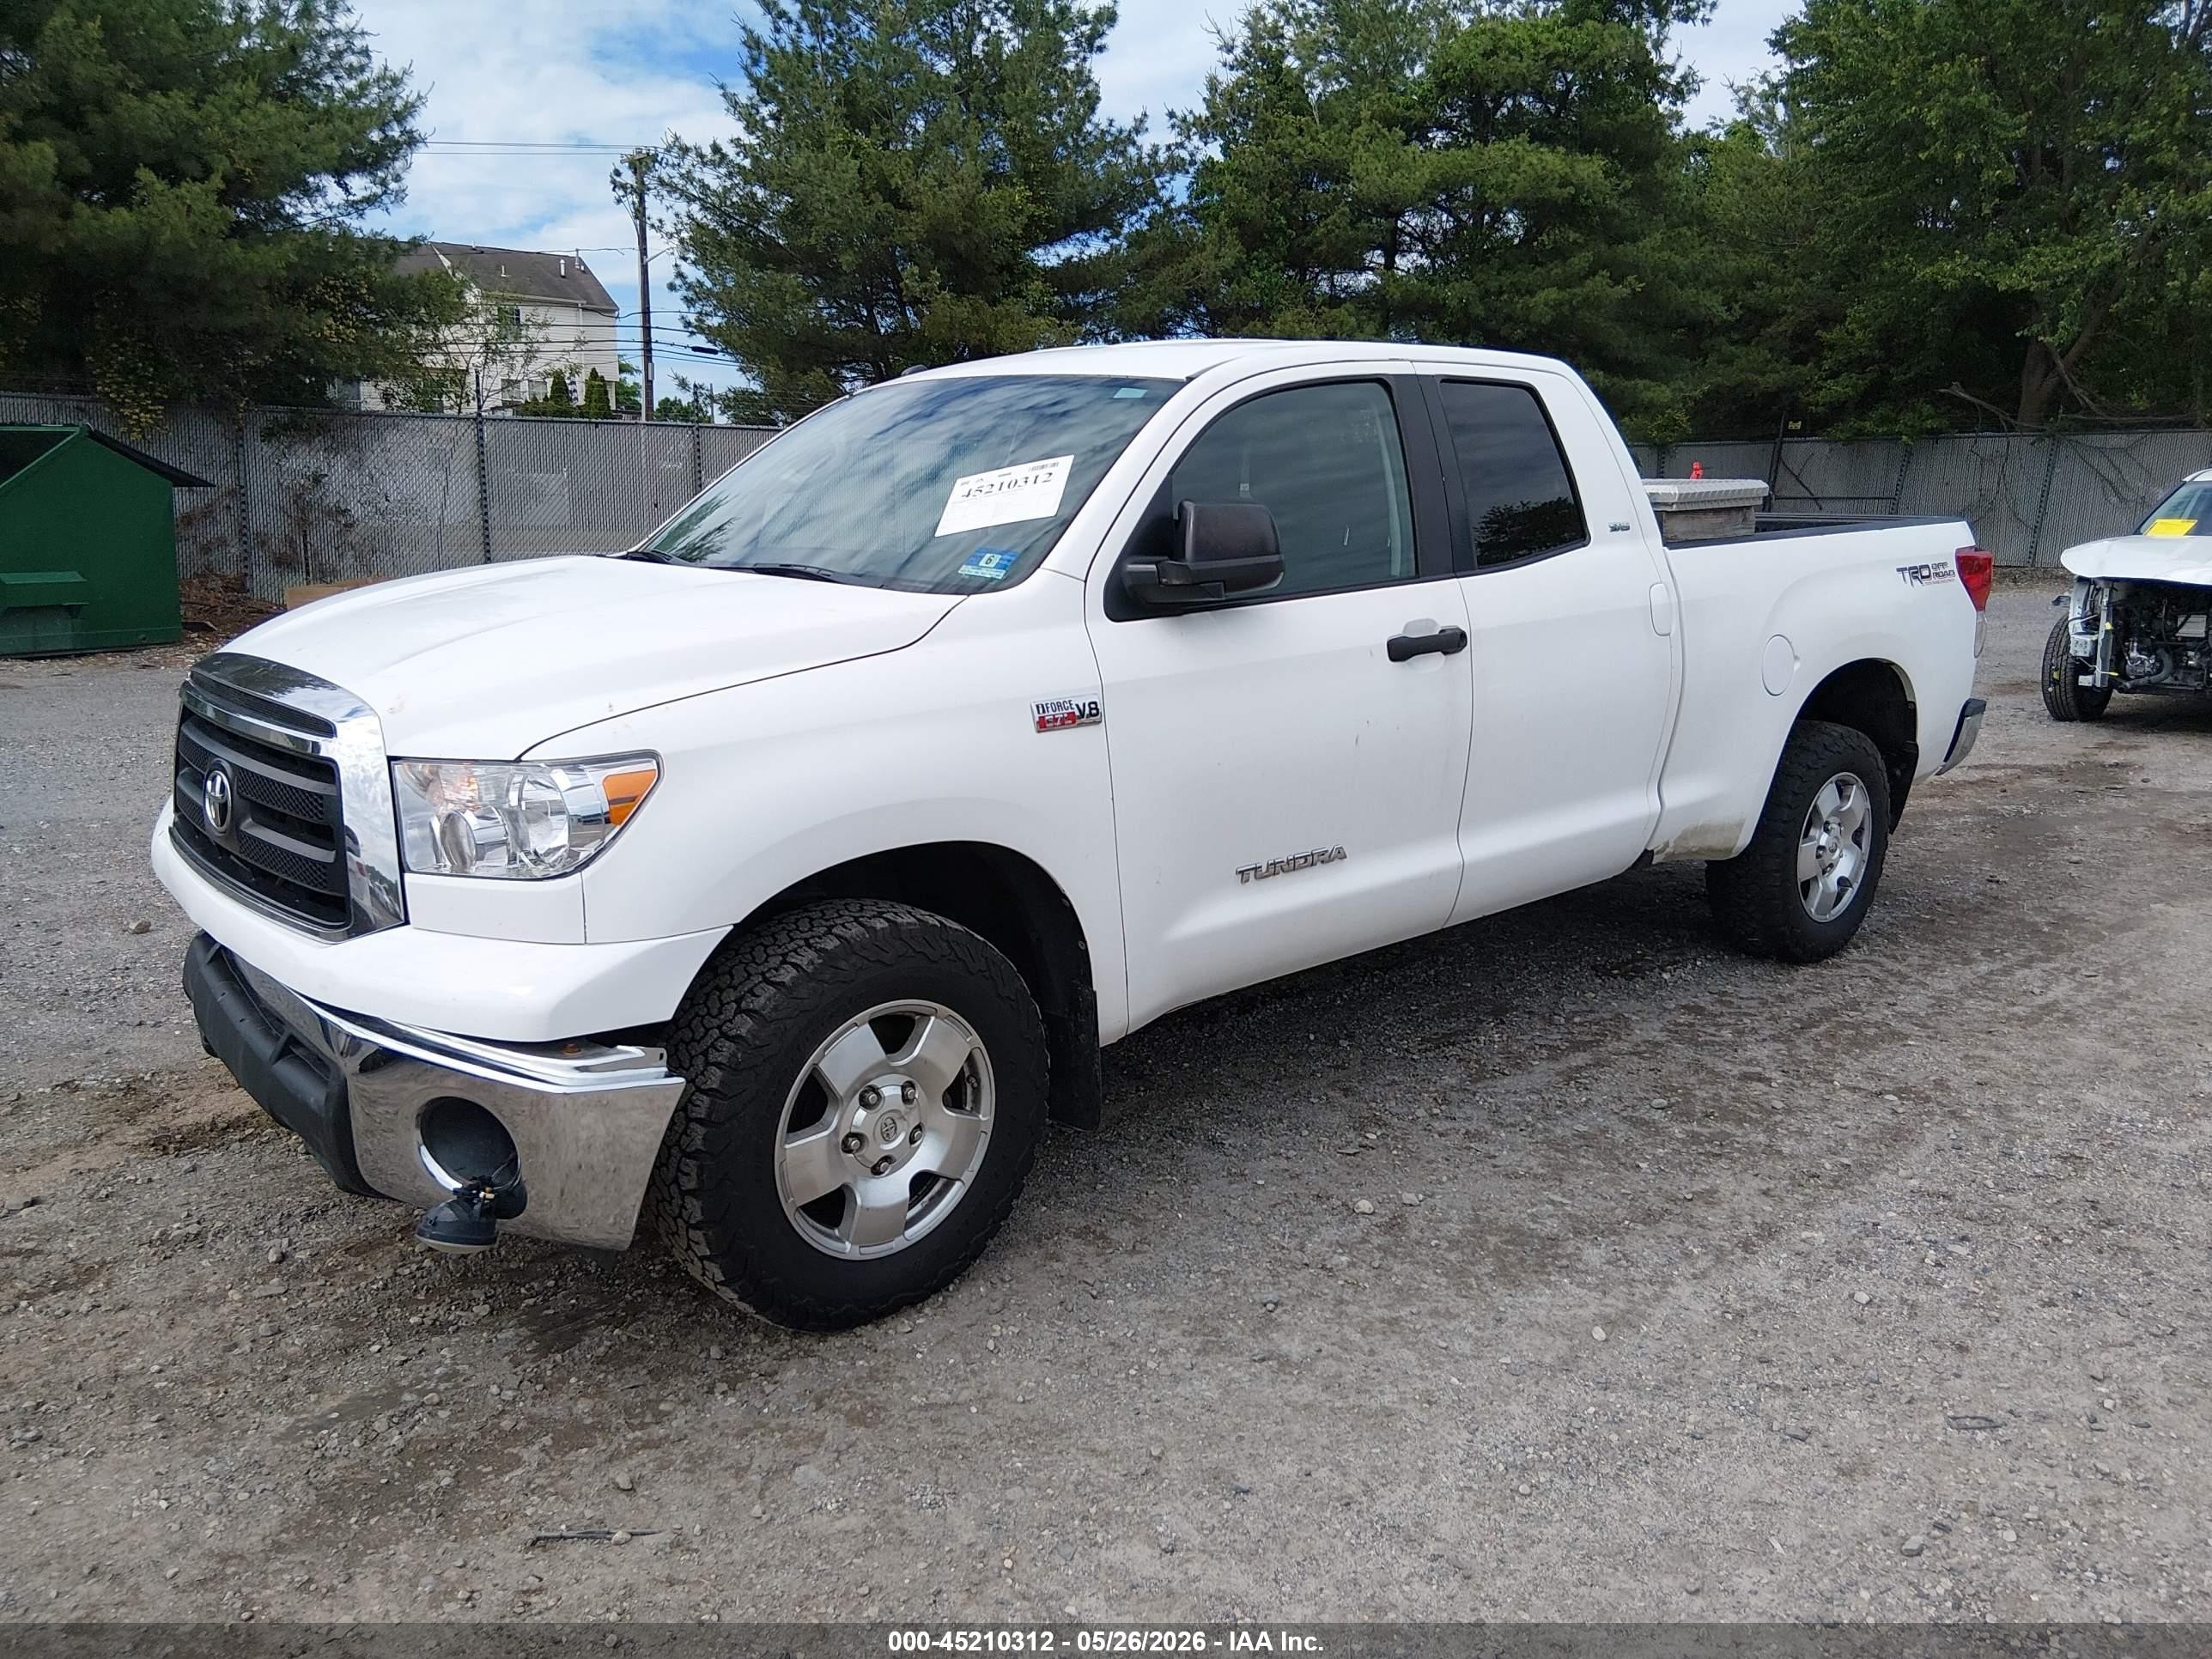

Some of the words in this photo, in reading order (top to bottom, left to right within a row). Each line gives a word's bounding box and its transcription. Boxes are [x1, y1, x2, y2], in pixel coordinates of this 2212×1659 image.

[961, 471, 1054, 498] 45210312
[1896, 564, 1931, 588] TRD
[1931, 562, 1948, 570] OFF
[1933, 569, 1955, 580] ROAD
[1075, 701, 1100, 720] V8
[1235, 844, 1347, 884] TUNDRA
